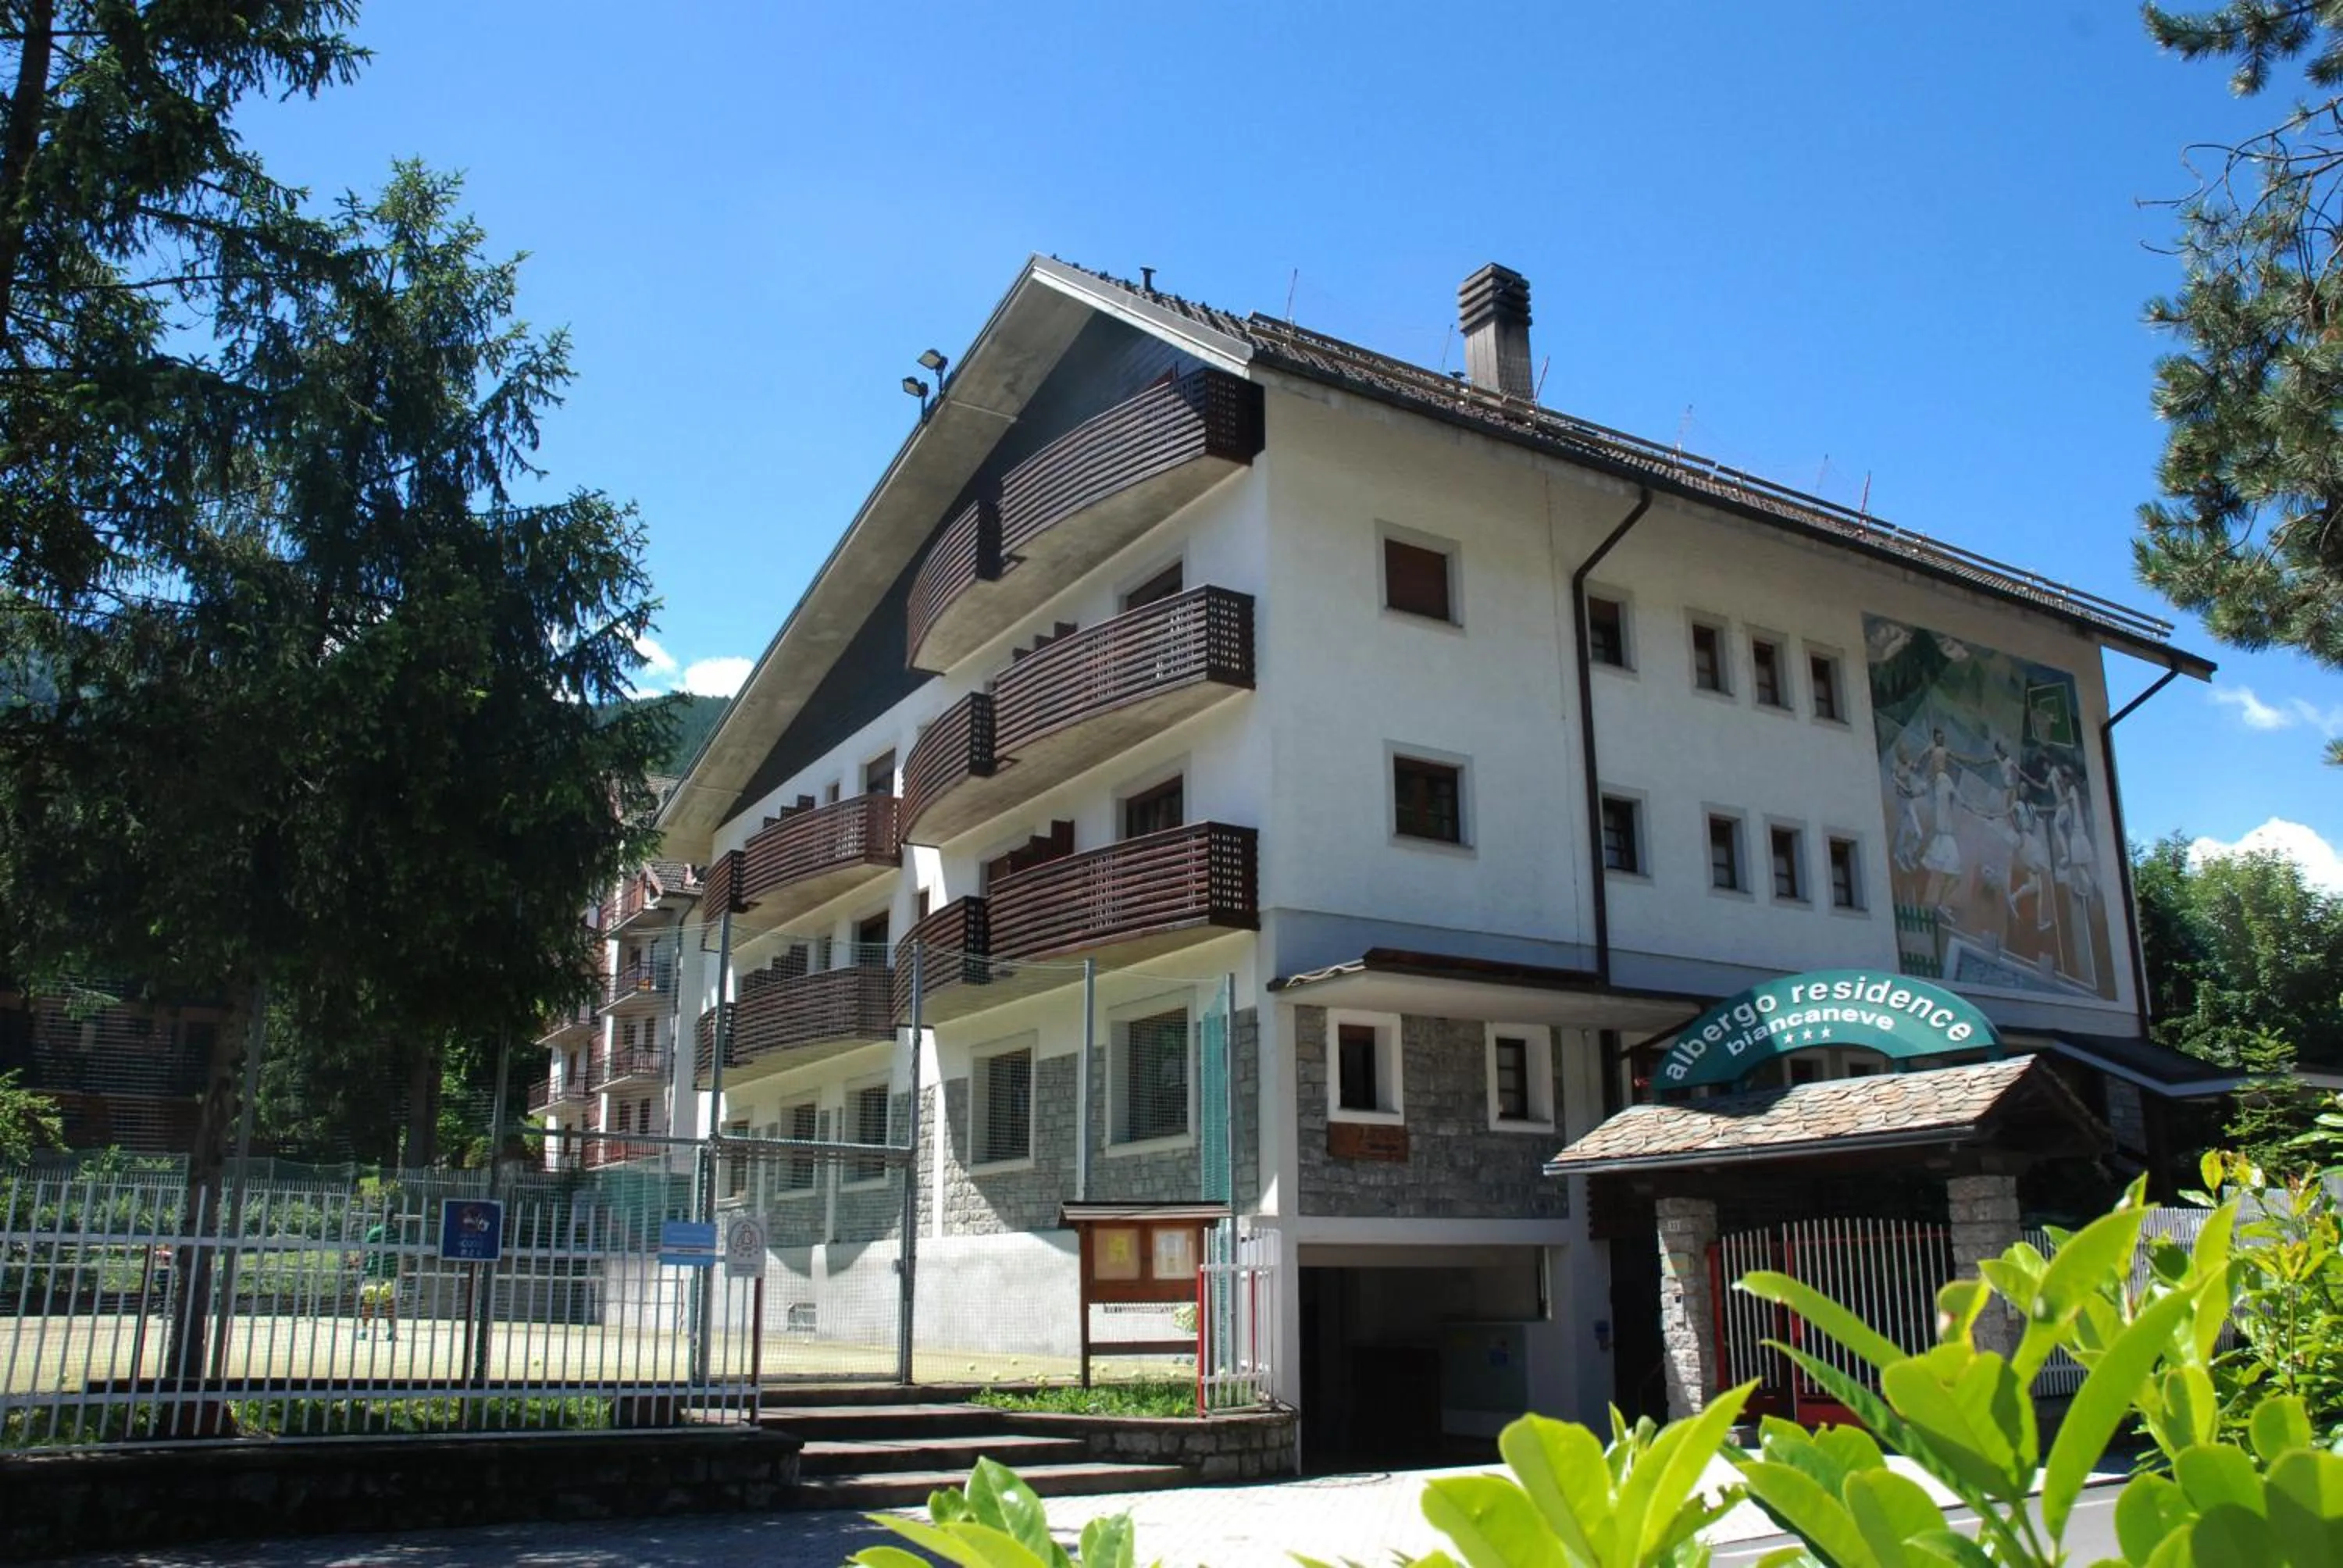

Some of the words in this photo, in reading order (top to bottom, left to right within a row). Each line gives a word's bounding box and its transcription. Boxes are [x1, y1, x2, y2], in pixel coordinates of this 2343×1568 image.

[1666, 995, 1777, 1080] albergo
[1791, 976, 1973, 1042] residence
[1726, 1007, 1895, 1057] biancaneve
